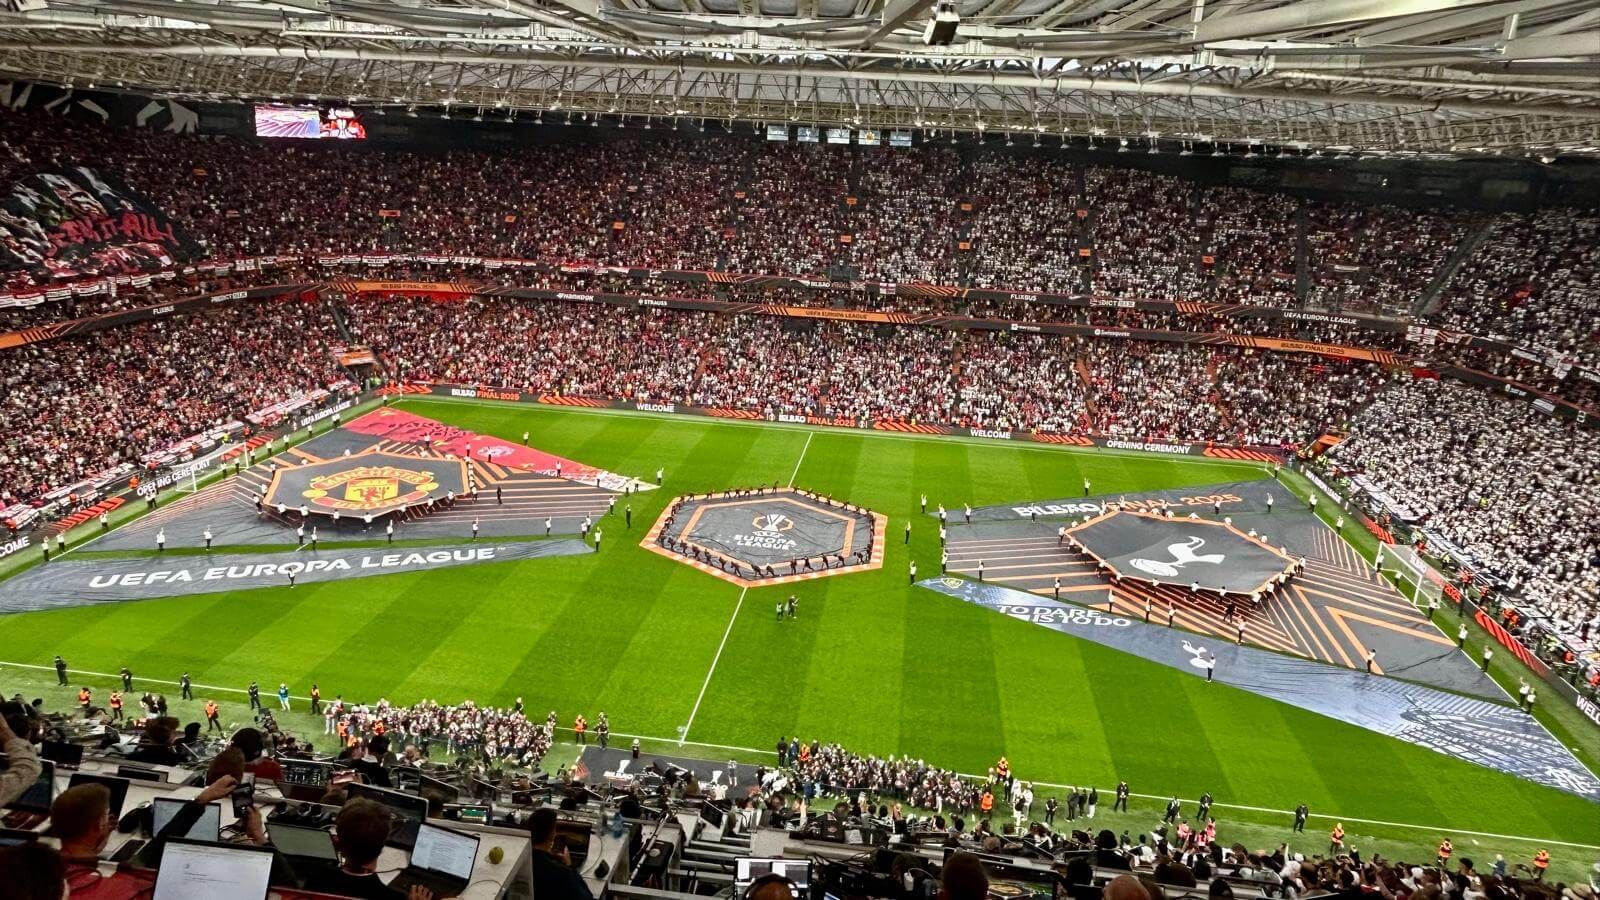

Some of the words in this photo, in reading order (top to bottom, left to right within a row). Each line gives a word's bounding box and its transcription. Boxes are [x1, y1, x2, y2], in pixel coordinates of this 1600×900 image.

[1010, 293, 1037, 302] FLIXBUS
[1283, 311, 1302, 319] UEFA
[1302, 313, 1329, 322] EUROPA
[1330, 316, 1358, 325] LEAGUE
[451, 388, 477, 397] BILBAO
[477, 389, 500, 399] FINAL
[500, 392, 520, 401] 2025
[636, 402, 675, 413] WELCOME
[778, 414, 806, 424] BILBAO
[807, 416, 833, 426] FINAL
[833, 418, 856, 427] 2025
[970, 429, 1011, 439] WELCOME
[1106, 439, 1144, 450] OPENING
[1144, 442, 1191, 455] CEREMONY
[1180, 493, 1243, 506] 2025
[734, 534, 797, 546] EUROPA
[736, 540, 790, 551] LEAGUE
[89, 569, 193, 588] UEFA
[203, 558, 352, 581] EUROPA
[360, 547, 496, 569] LEAGUE
[999, 605, 1030, 614] TO
[1033, 606, 1102, 618] DARE
[1033, 614, 1055, 623] IS
[1057, 615, 1092, 625] TO
[1093, 617, 1132, 627] DO
